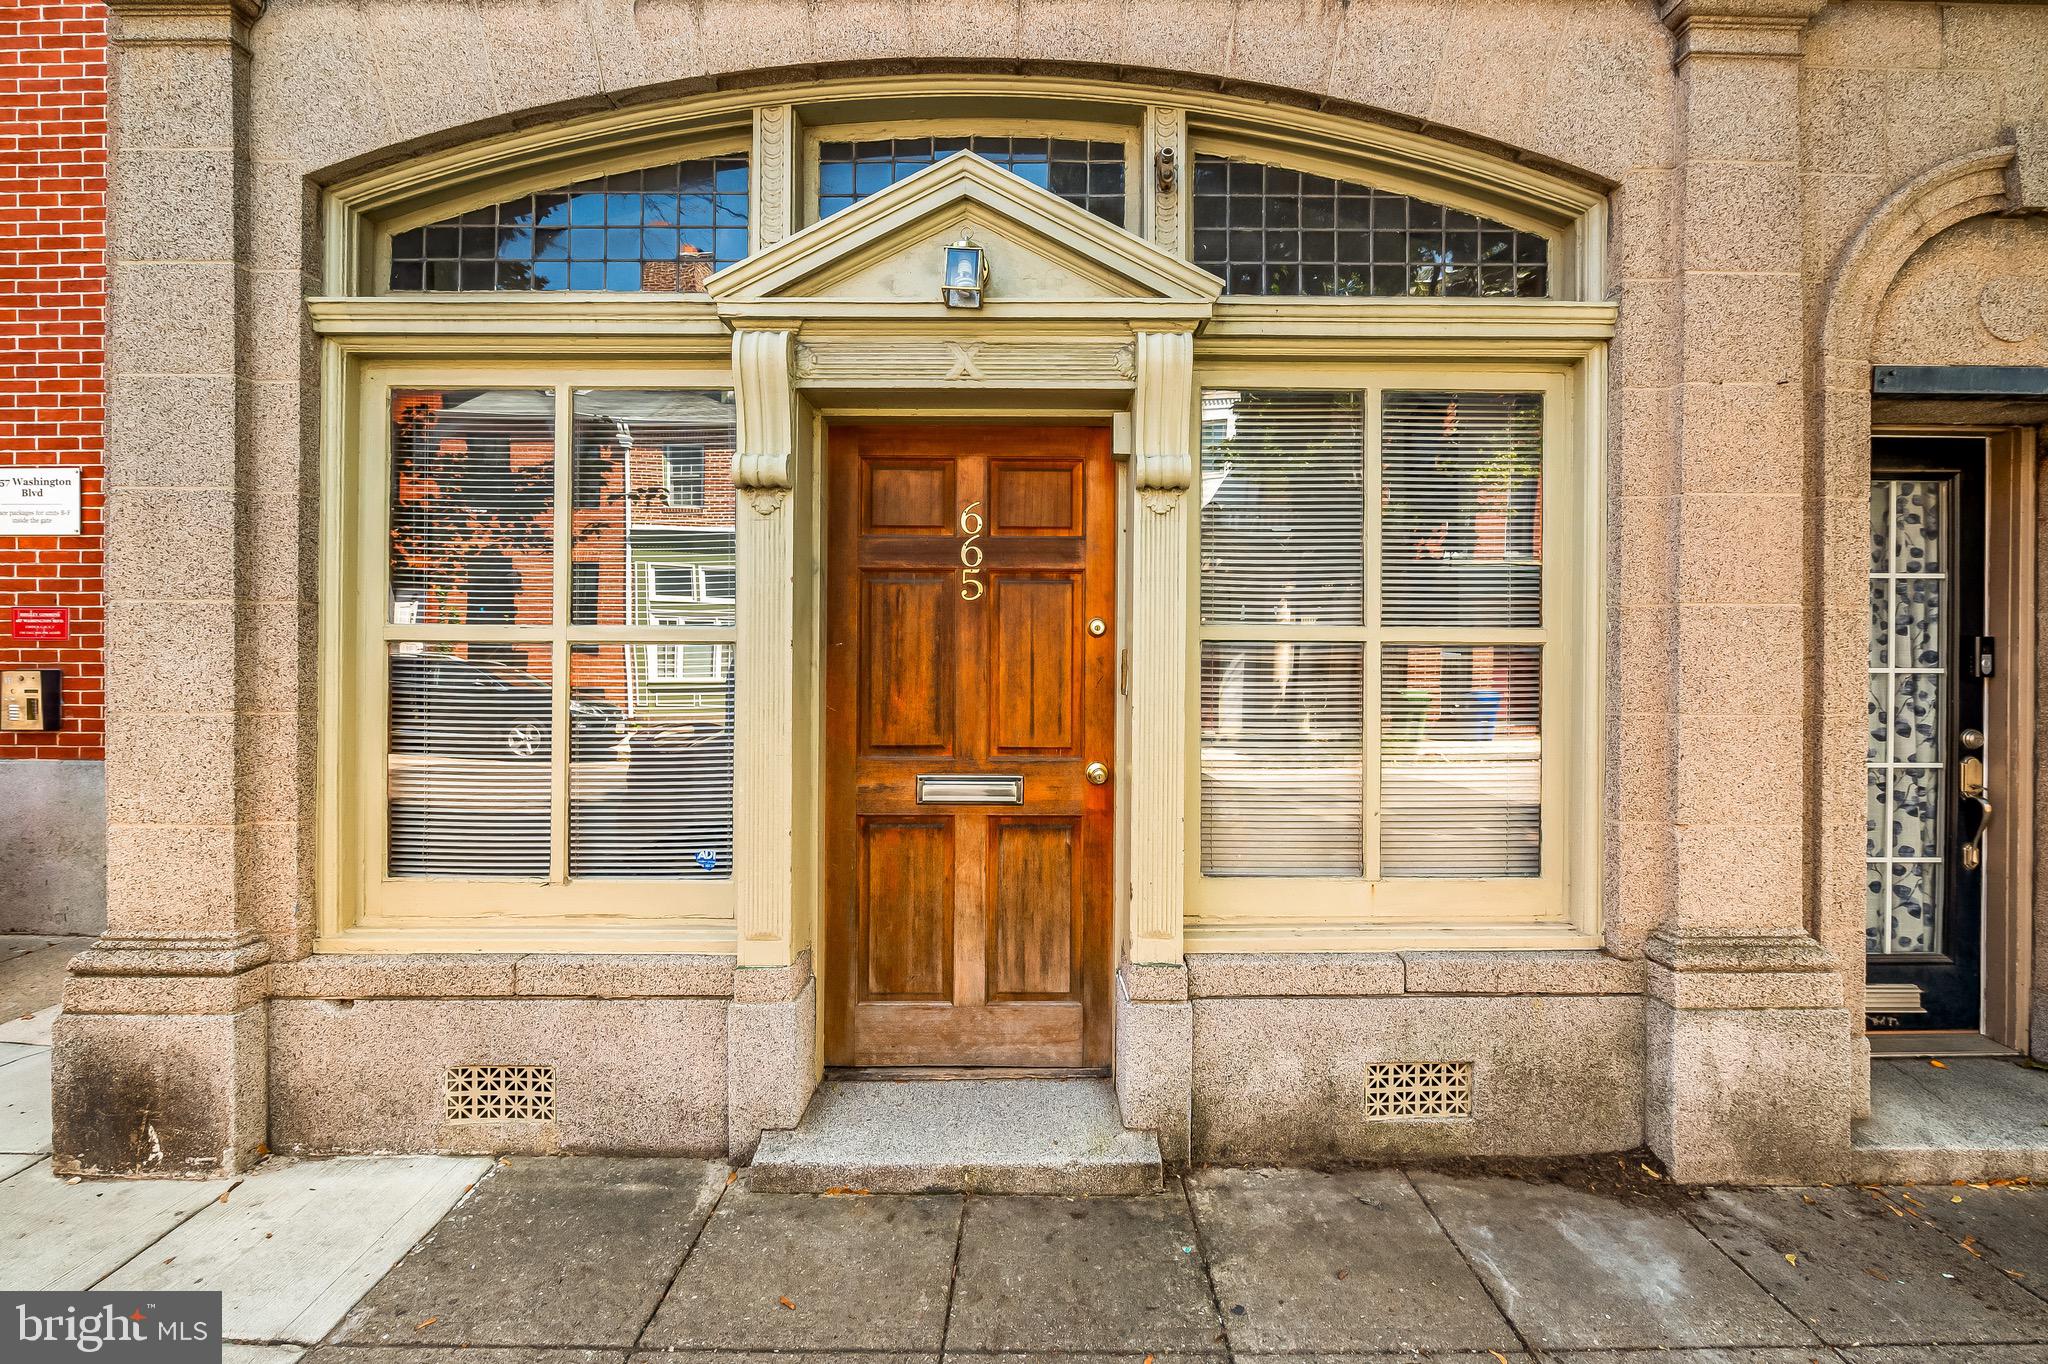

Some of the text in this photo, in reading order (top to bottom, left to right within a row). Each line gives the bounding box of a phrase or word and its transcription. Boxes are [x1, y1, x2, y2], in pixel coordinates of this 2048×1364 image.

[12, 477, 72, 488] Washington
[22, 488, 43, 497] Blvd
[960, 501, 983, 601] 665
